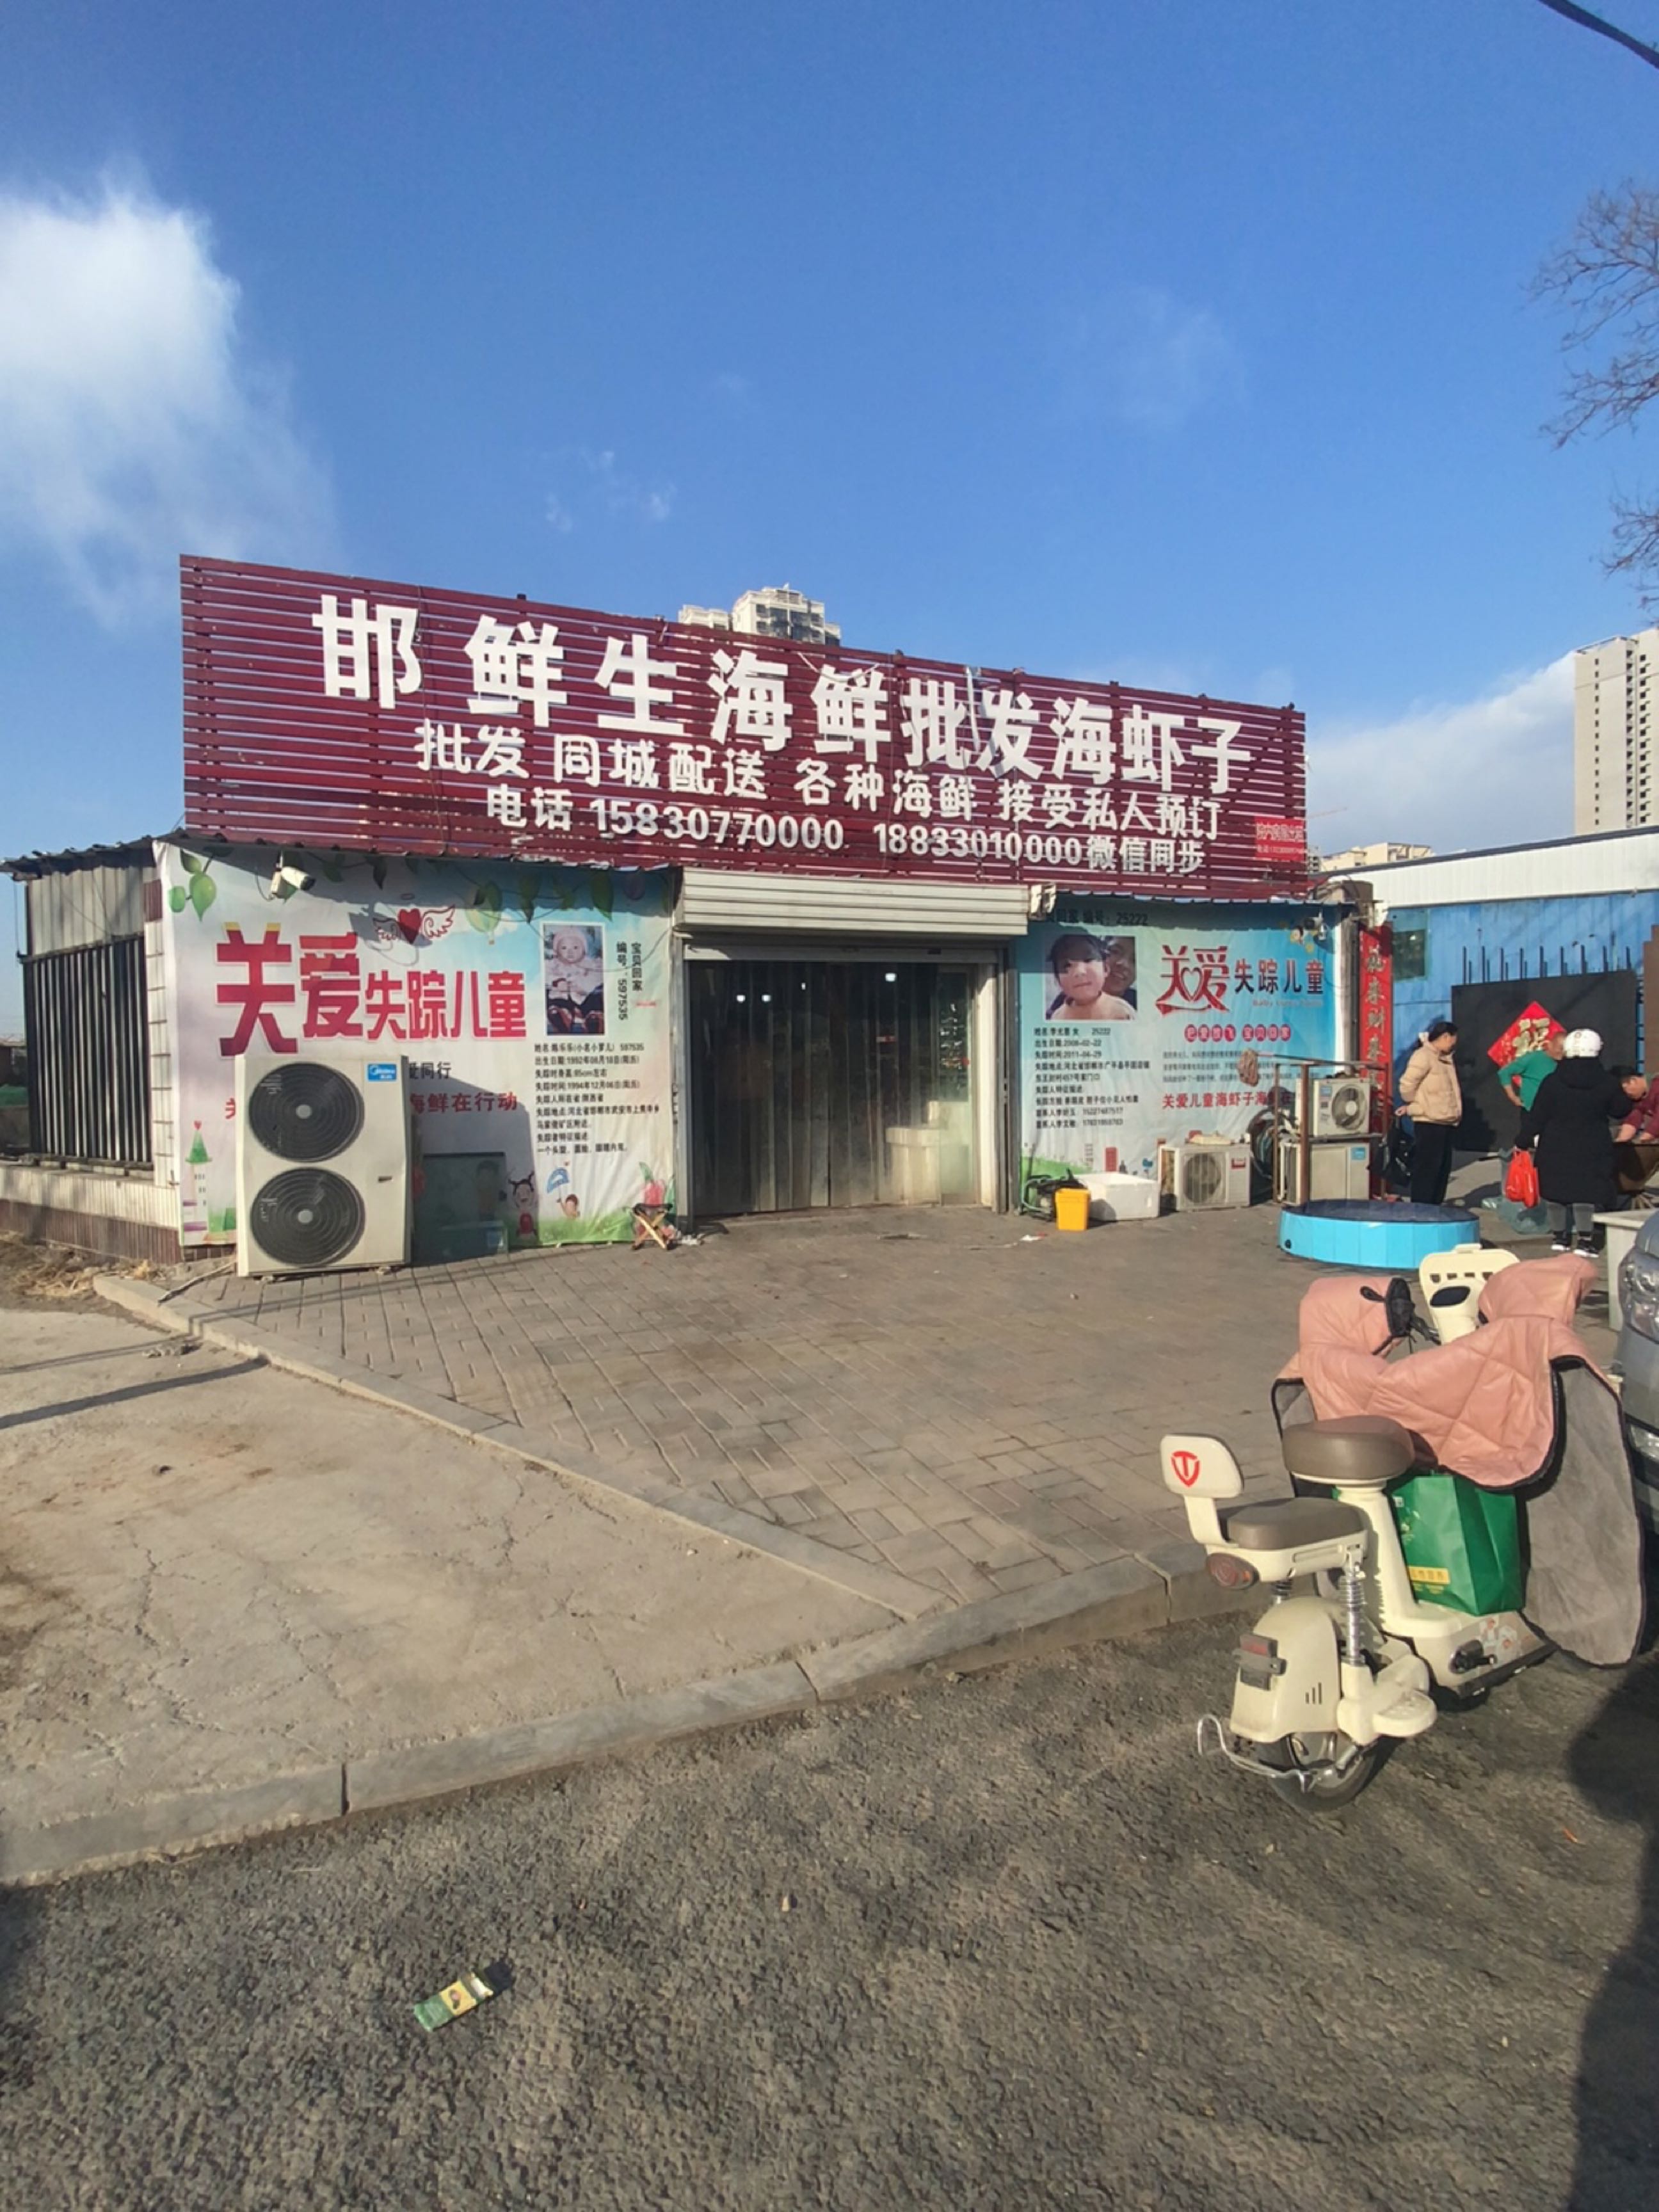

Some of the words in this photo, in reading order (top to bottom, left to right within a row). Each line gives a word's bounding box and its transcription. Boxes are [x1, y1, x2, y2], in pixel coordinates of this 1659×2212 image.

[414, 718, 530, 779] 批发
[553, 733, 767, 799] 同城配送
[794, 757, 977, 822] 各种海鲜
[997, 779, 1221, 840] 接受私人预订
[486, 784, 573, 831] 电话
[589, 797, 844, 851] 15830770000
[216, 922, 527, 1057] 关爱失踪儿童
[1155, 945, 1324, 1015] 关爱失踪儿童
